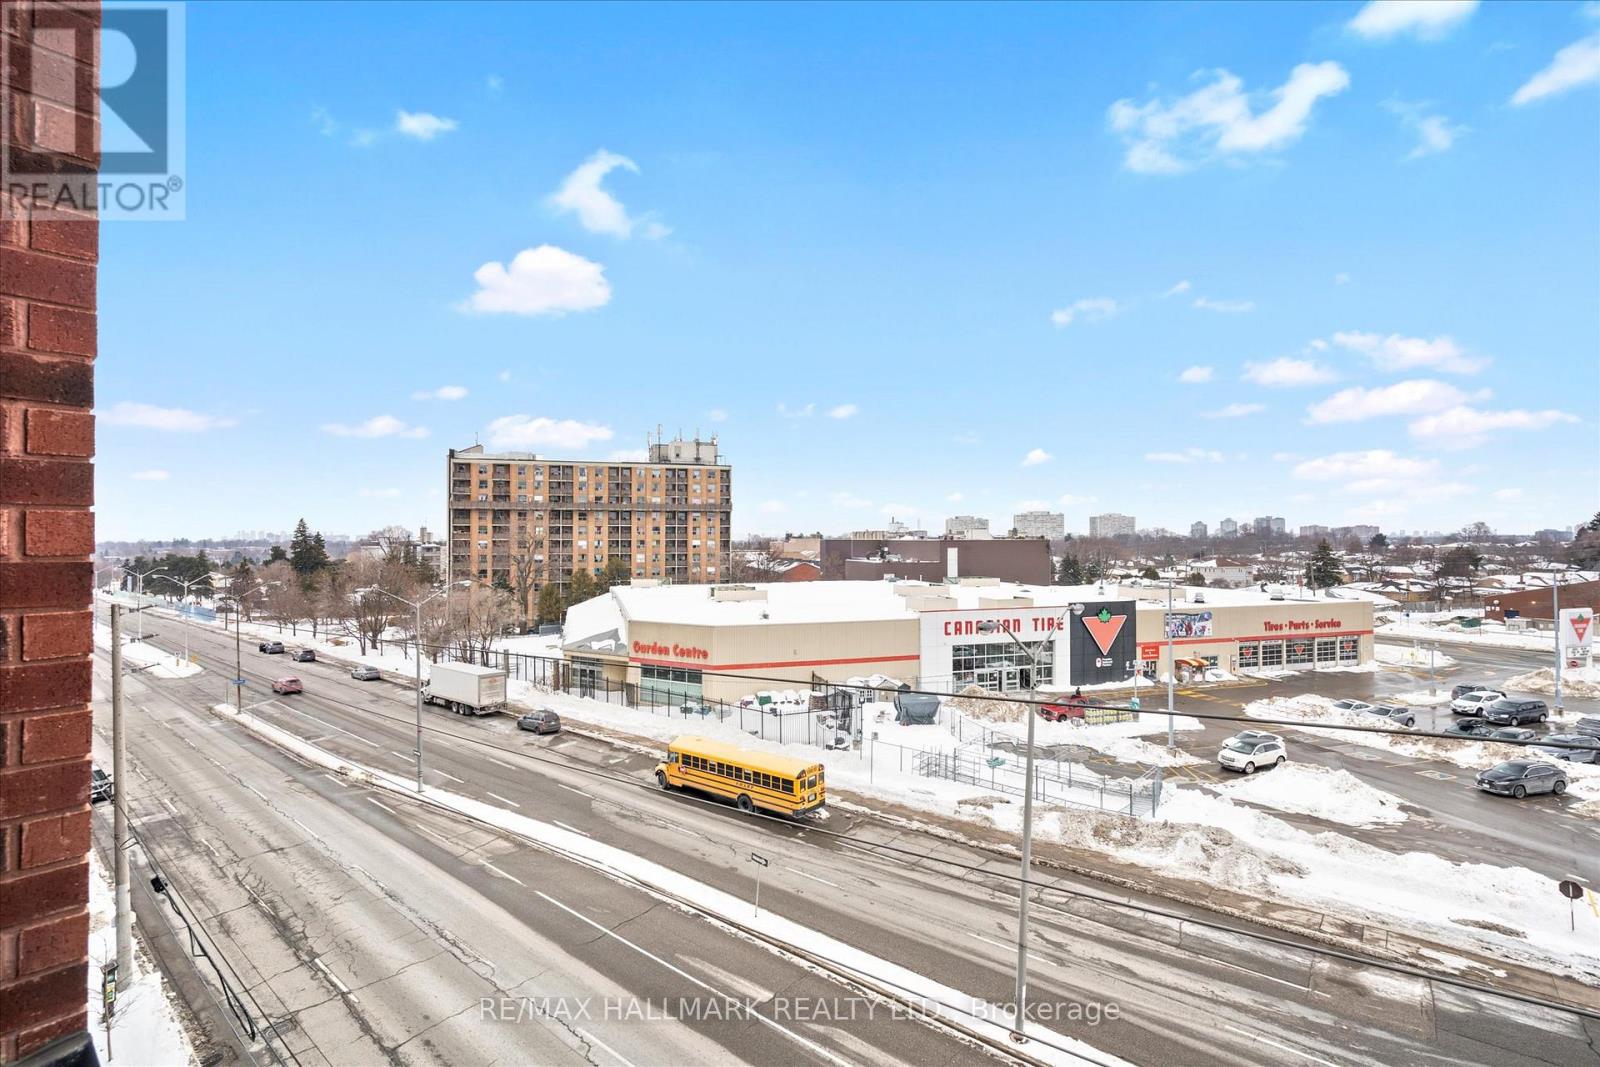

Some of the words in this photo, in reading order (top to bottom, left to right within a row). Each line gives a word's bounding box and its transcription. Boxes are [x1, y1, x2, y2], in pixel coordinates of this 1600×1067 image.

[1032, 616, 1064, 632] TIRE
[1263, 621, 1284, 632] Tires
[1288, 620, 1310, 631] Parts
[1314, 618, 1342, 629] Service
[633, 640, 671, 656] Garden
[673, 643, 709, 660] Centre
